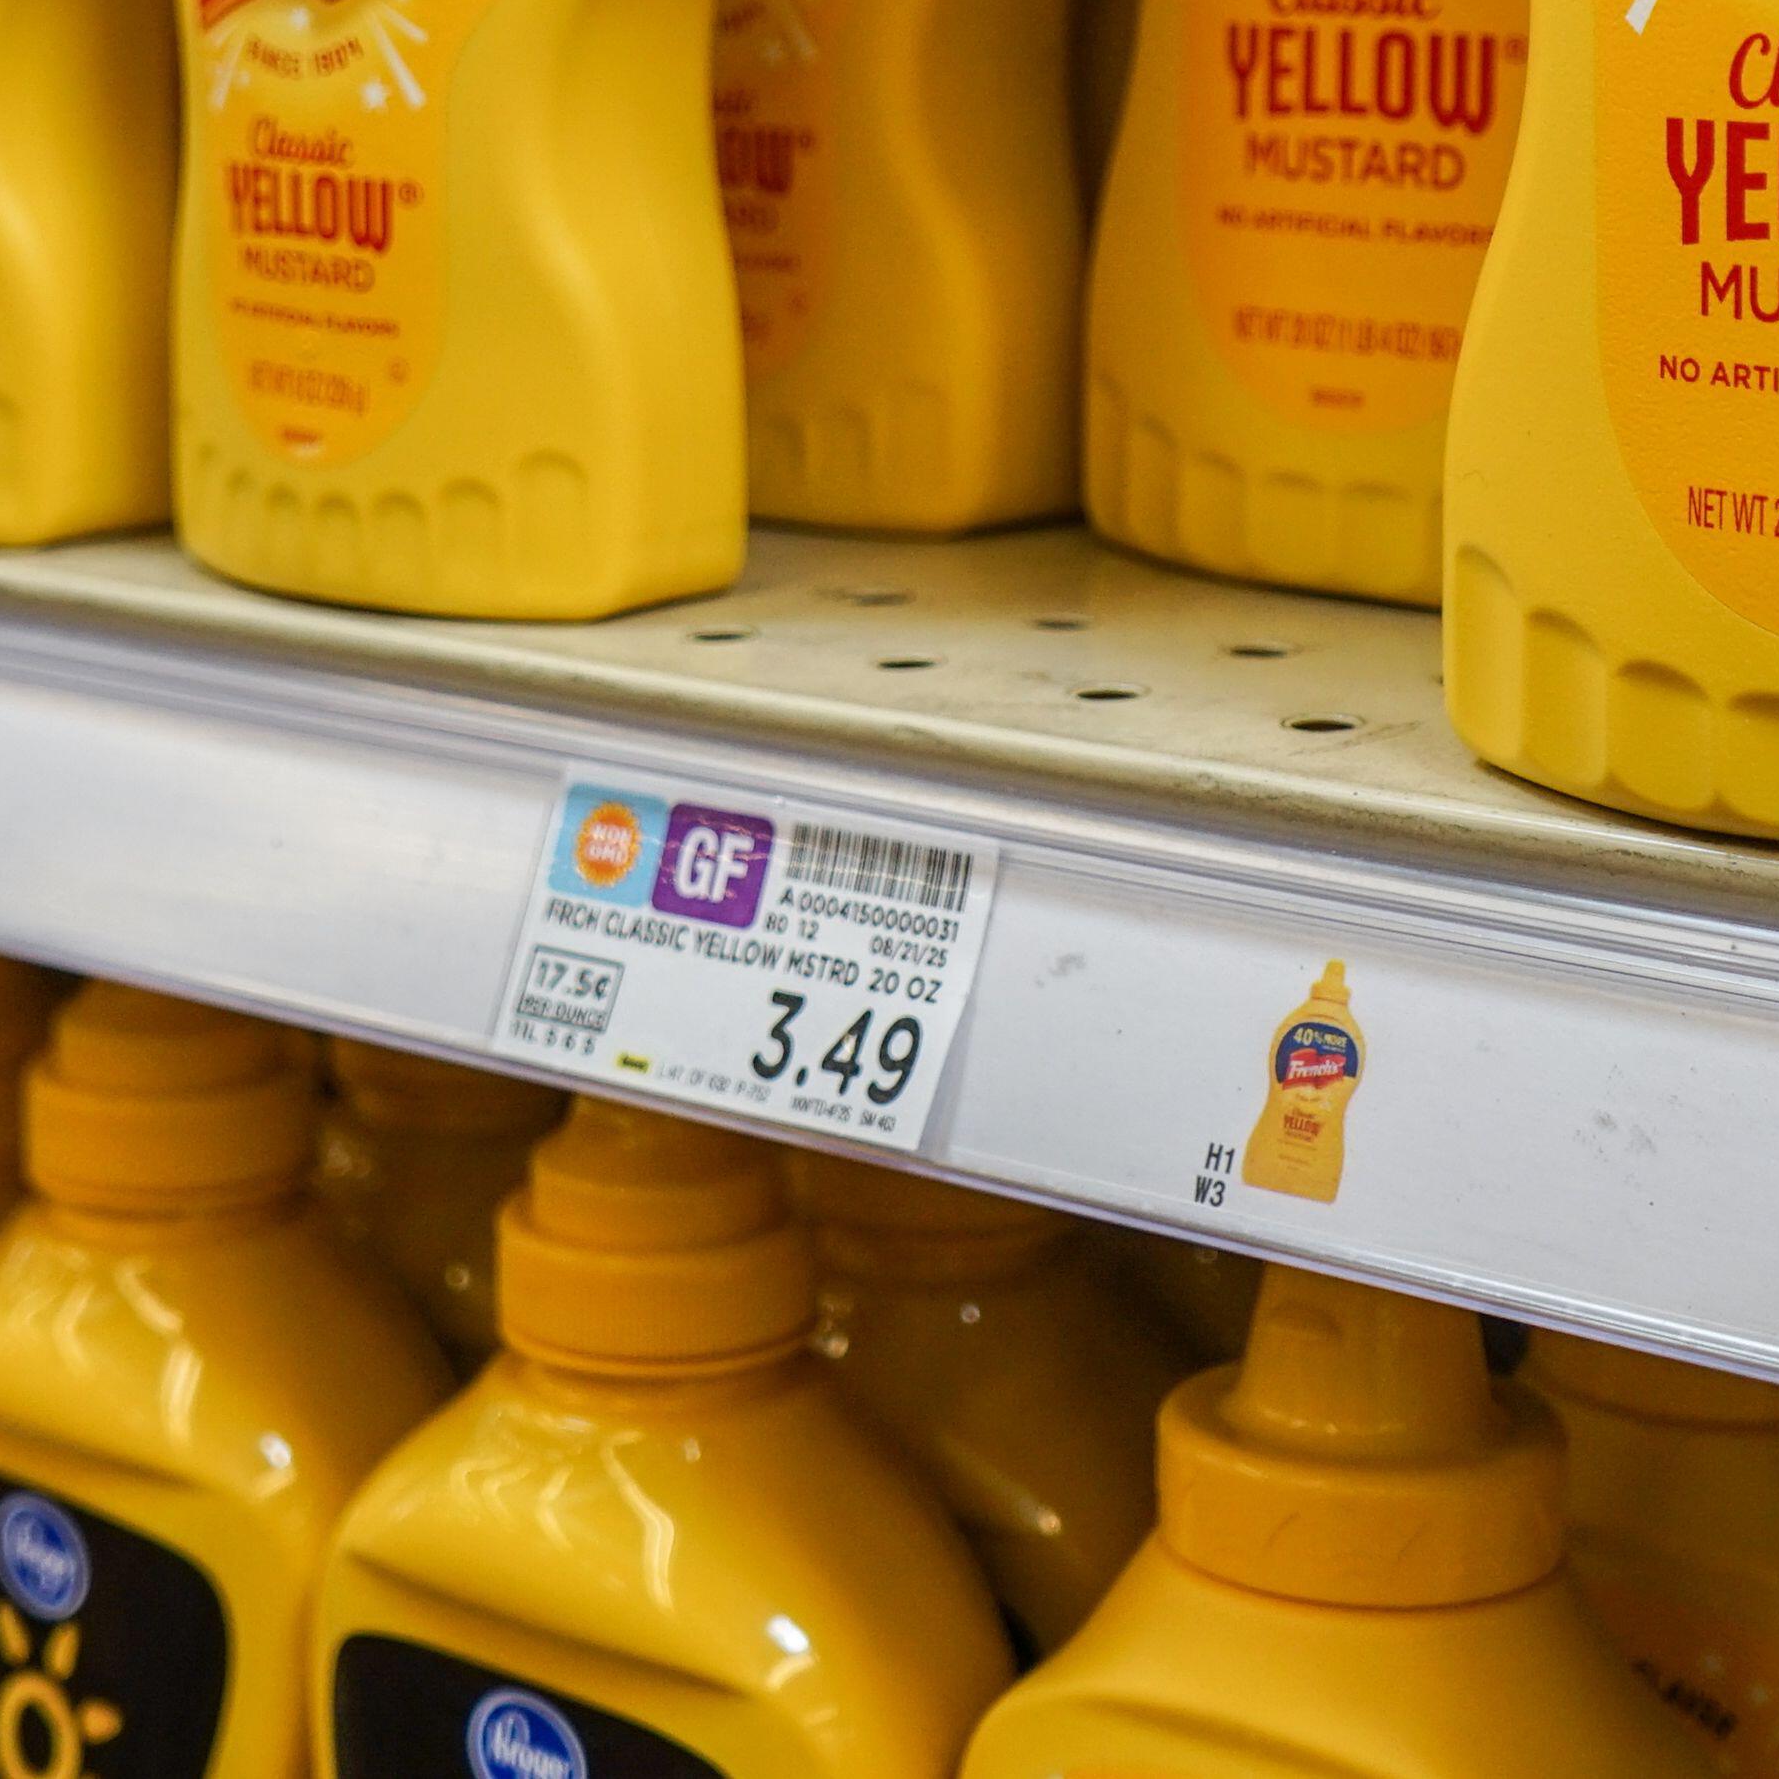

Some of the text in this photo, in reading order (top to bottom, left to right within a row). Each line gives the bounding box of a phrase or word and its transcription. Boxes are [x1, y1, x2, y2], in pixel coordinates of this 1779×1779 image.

[1243, 132, 1469, 193] MUSTARD
[1658, 354, 1702, 385] NO
[1687, 485, 1728, 531] NET
[1732, 492, 1770, 537] WT
[675, 825, 756, 904] GF
[779, 886, 795, 907] A
[797, 919, 820, 941] 12
[545, 898, 944, 1004] FRCH CLASSIC YELLOW MSTRD 20 OZ
[871, 935, 950, 970] 08/21/25
[752, 990, 922, 1106] 3.49
[1205, 1142, 1236, 1176] H1
[1194, 1175, 1226, 1208] W3
